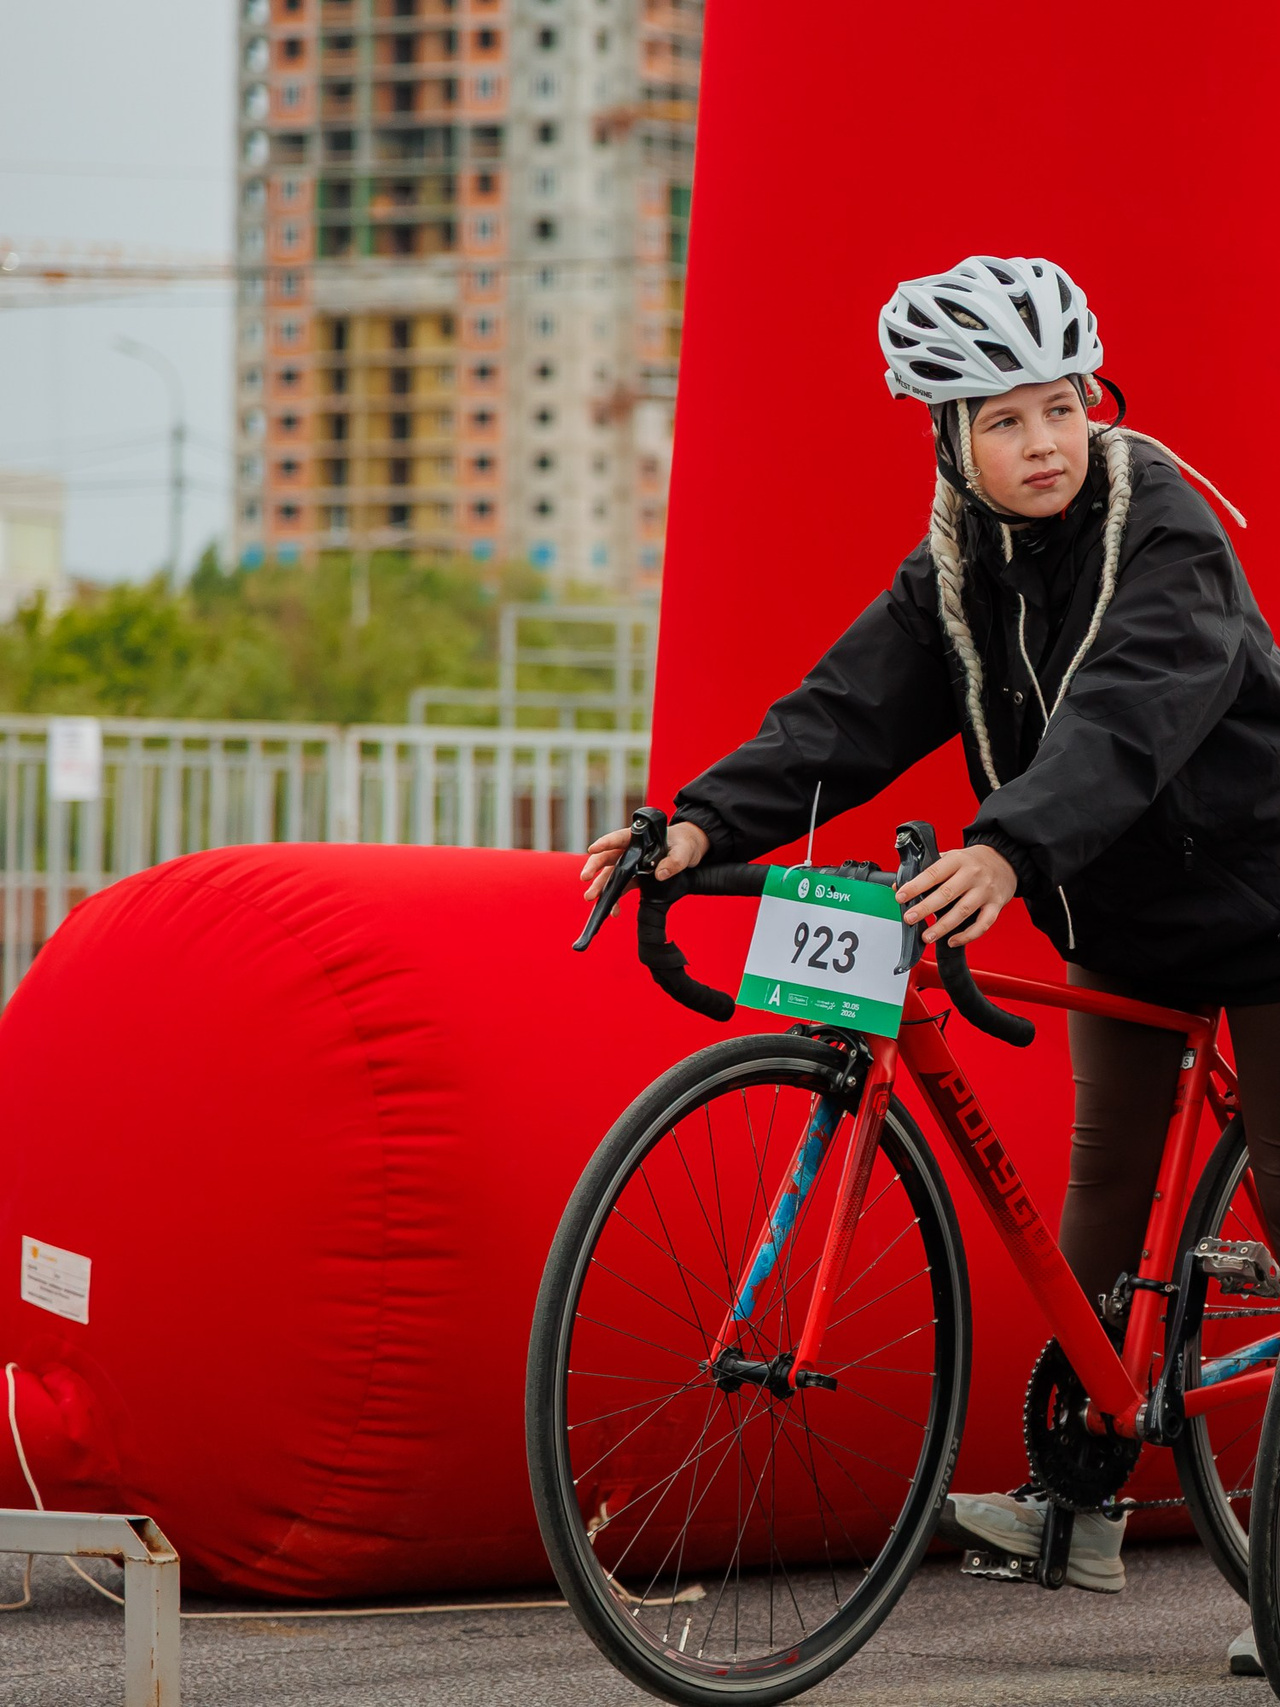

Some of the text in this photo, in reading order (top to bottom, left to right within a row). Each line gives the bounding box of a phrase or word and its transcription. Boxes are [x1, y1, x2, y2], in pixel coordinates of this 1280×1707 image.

[825, 887, 851, 902] Звук
[790, 921, 860, 974] 923
[841, 1001, 860, 1011] 30.05
[840, 1009, 857, 1019] 2026
[934, 1436, 959, 1509] KENDA
